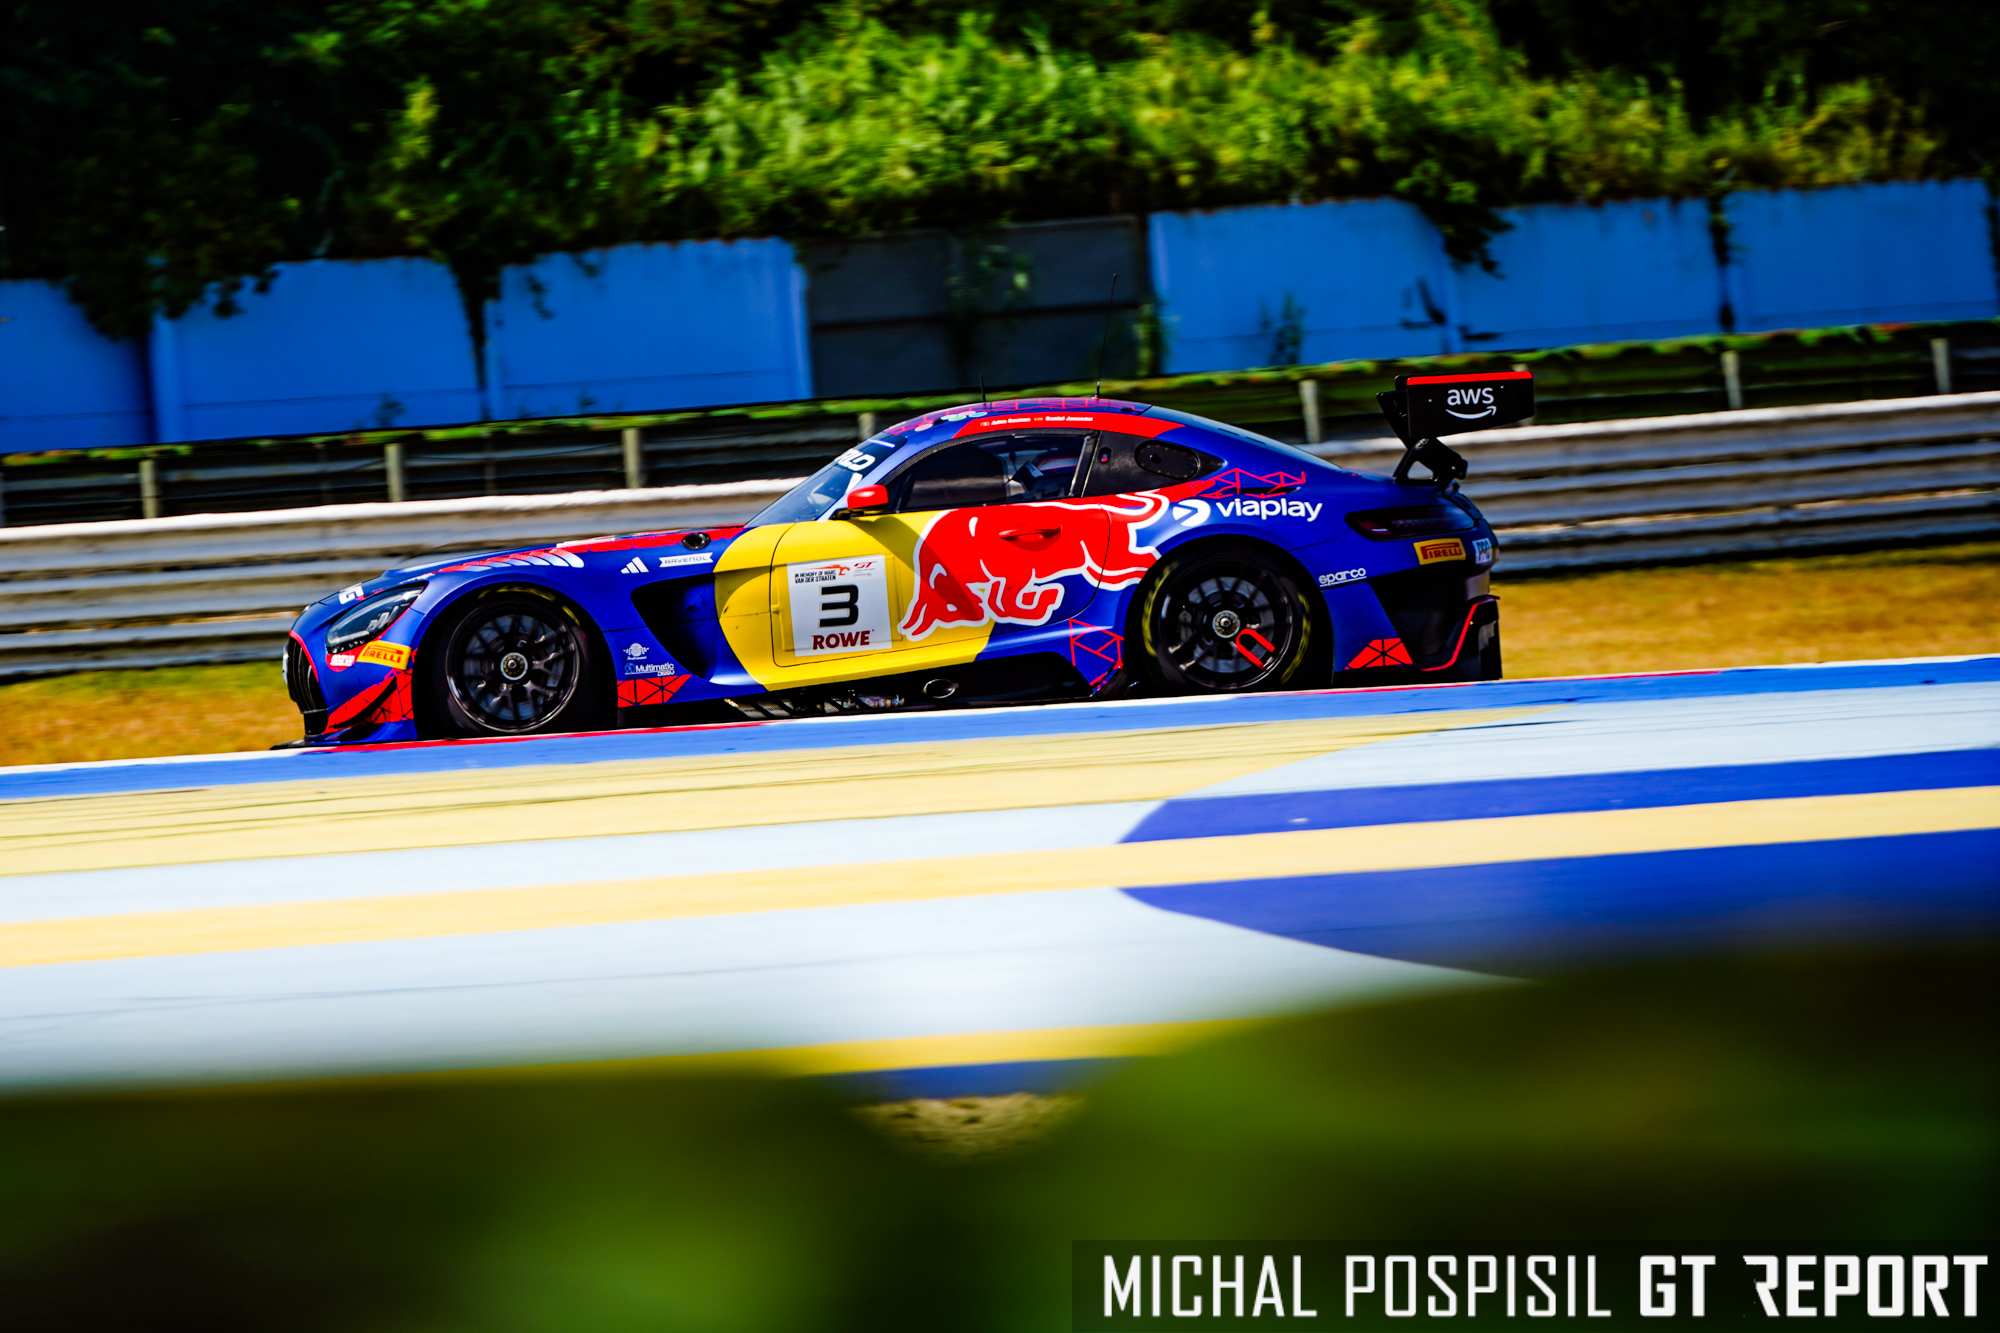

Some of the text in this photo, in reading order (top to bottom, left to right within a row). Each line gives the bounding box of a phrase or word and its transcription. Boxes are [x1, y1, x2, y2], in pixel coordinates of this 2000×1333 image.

[1447, 387, 1494, 405] aws
[1216, 498, 1323, 522] viaplay
[664, 555, 708, 564] RAVENOL
[1419, 542, 1463, 560] PIRELLI
[1319, 567, 1367, 586] sparco
[819, 584, 858, 628] 3
[811, 630, 871, 651] ROWE
[362, 644, 404, 664] PIRELLI
[635, 662, 675, 673] Multimatic
